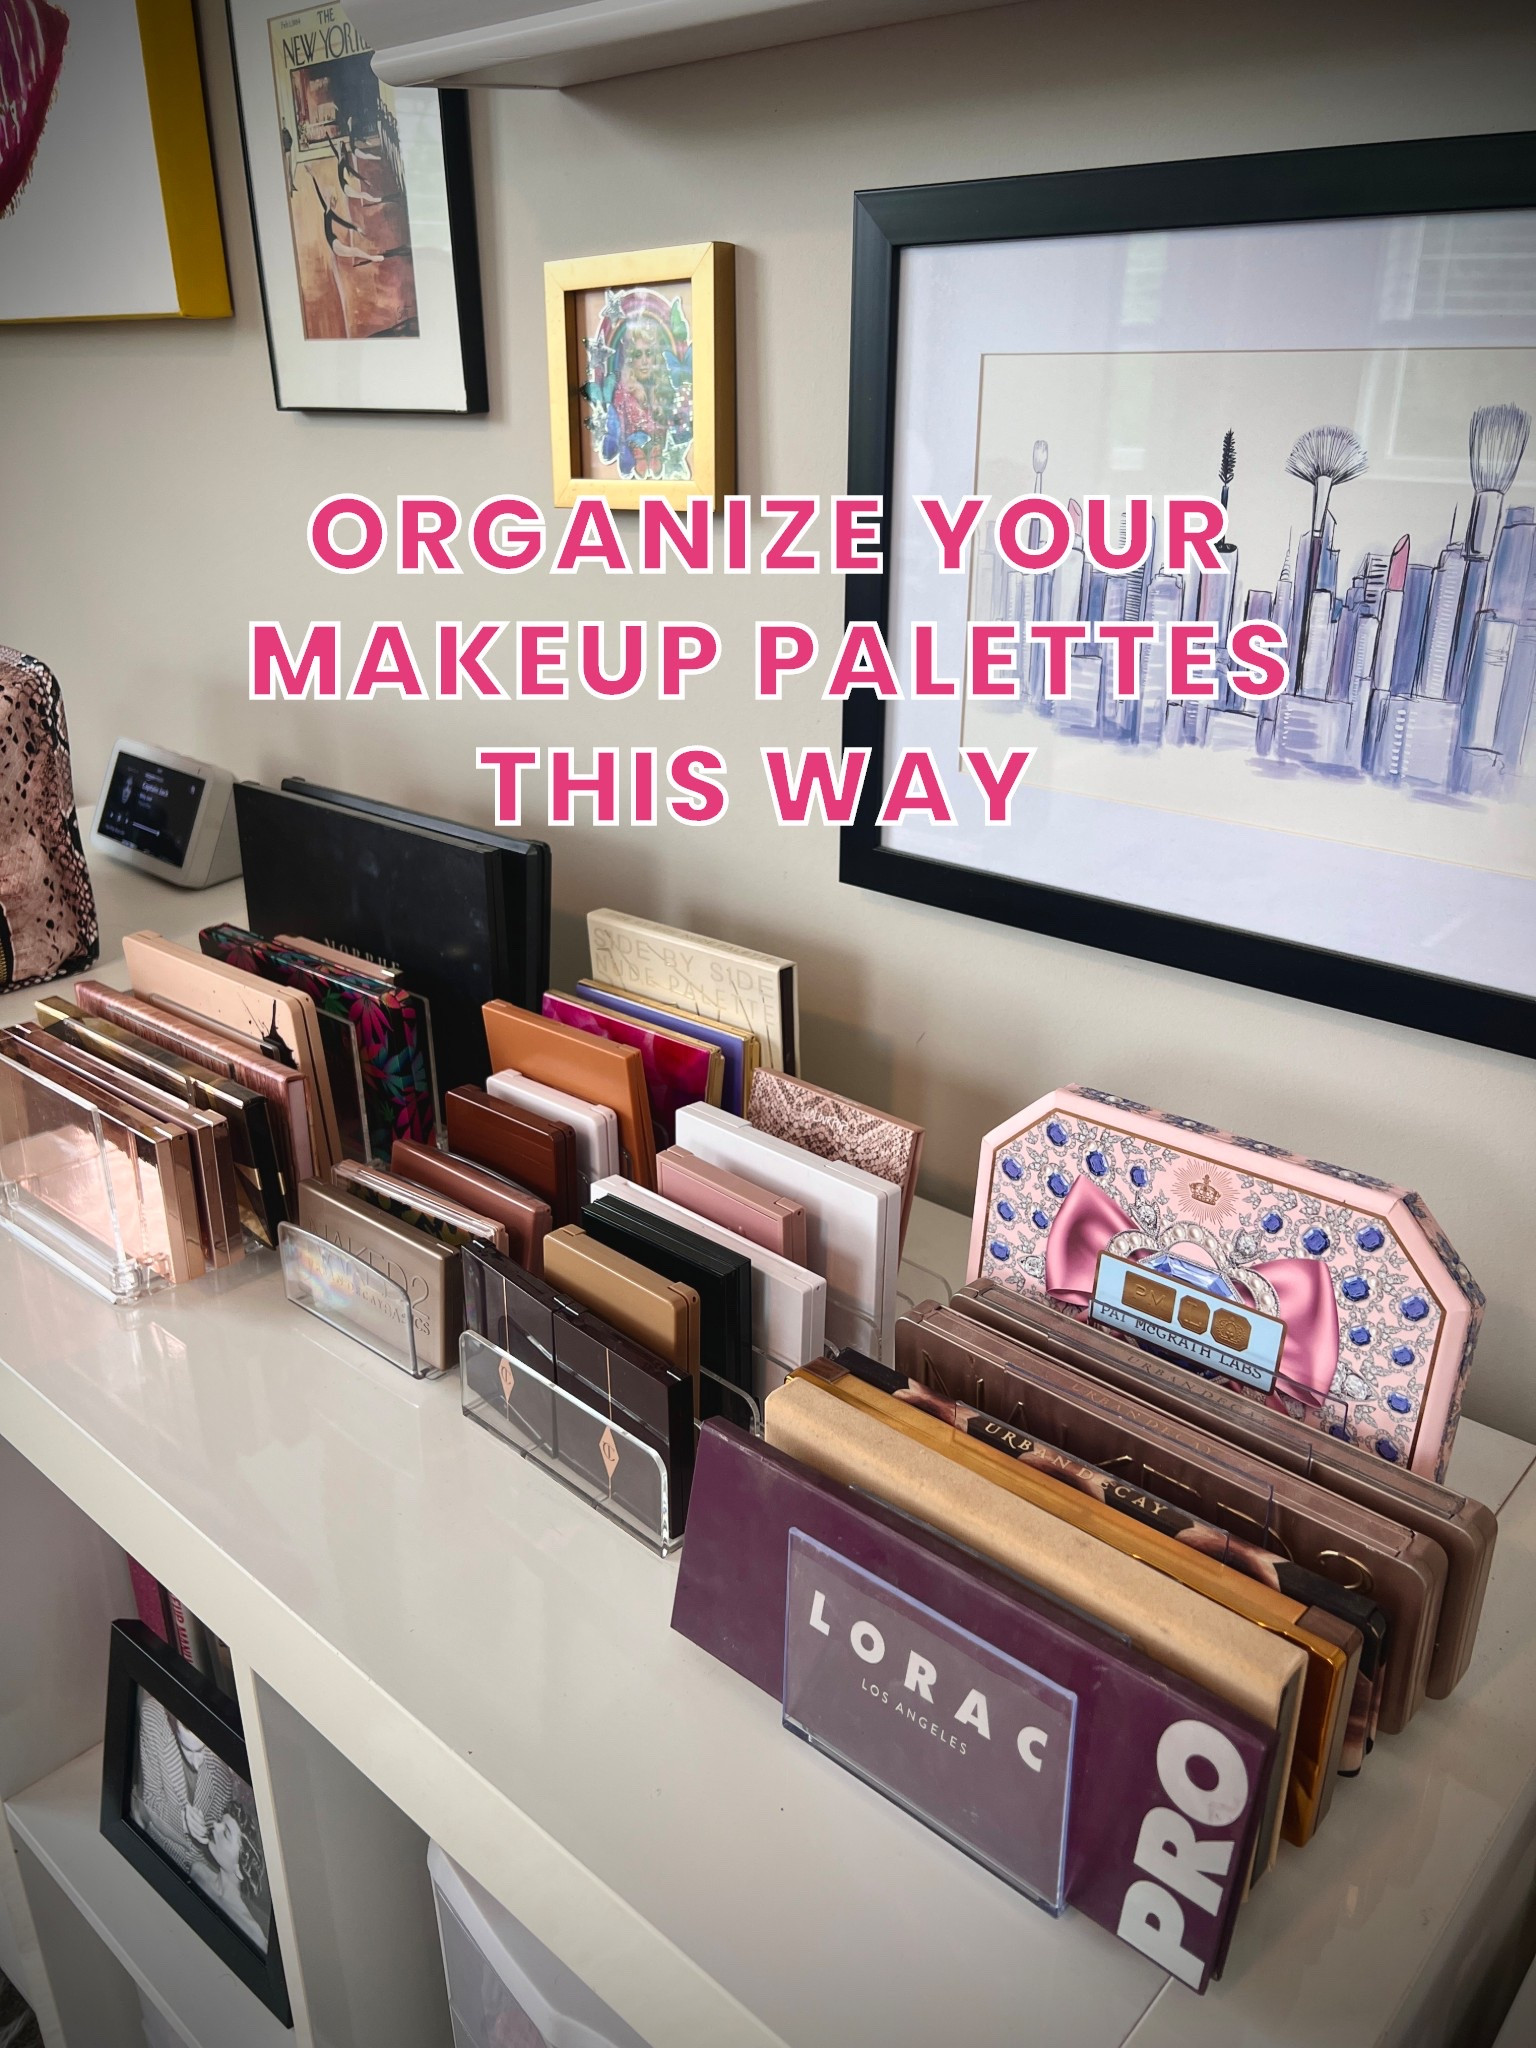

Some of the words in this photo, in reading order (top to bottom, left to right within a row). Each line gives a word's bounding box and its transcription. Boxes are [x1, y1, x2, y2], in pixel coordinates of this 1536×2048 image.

[282, 31, 317, 69] NEW
[316, 8, 335, 24] THE
[593, 927, 651, 962] SIDE
[663, 947, 694, 973] BY
[709, 961, 775, 996] SIDE
[594, 951, 656, 988] NUDE
[668, 973, 776, 1028] PALETTE
[1100, 1302, 1128, 1324] PAT
[1218, 1352, 1263, 1381] LABS
[1126, 1355, 1196, 1393] URBAN
[1071, 1383, 1142, 1420] URBAN
[984, 1422, 1072, 1469] URBAN
[1074, 1465, 1169, 1516] DECAY
[808, 1589, 1049, 1774] LORAC
[861, 1677, 889, 1704] LOS
[895, 1702, 967, 1755] ANGELES
[1115, 1718, 1250, 1992] PRO
